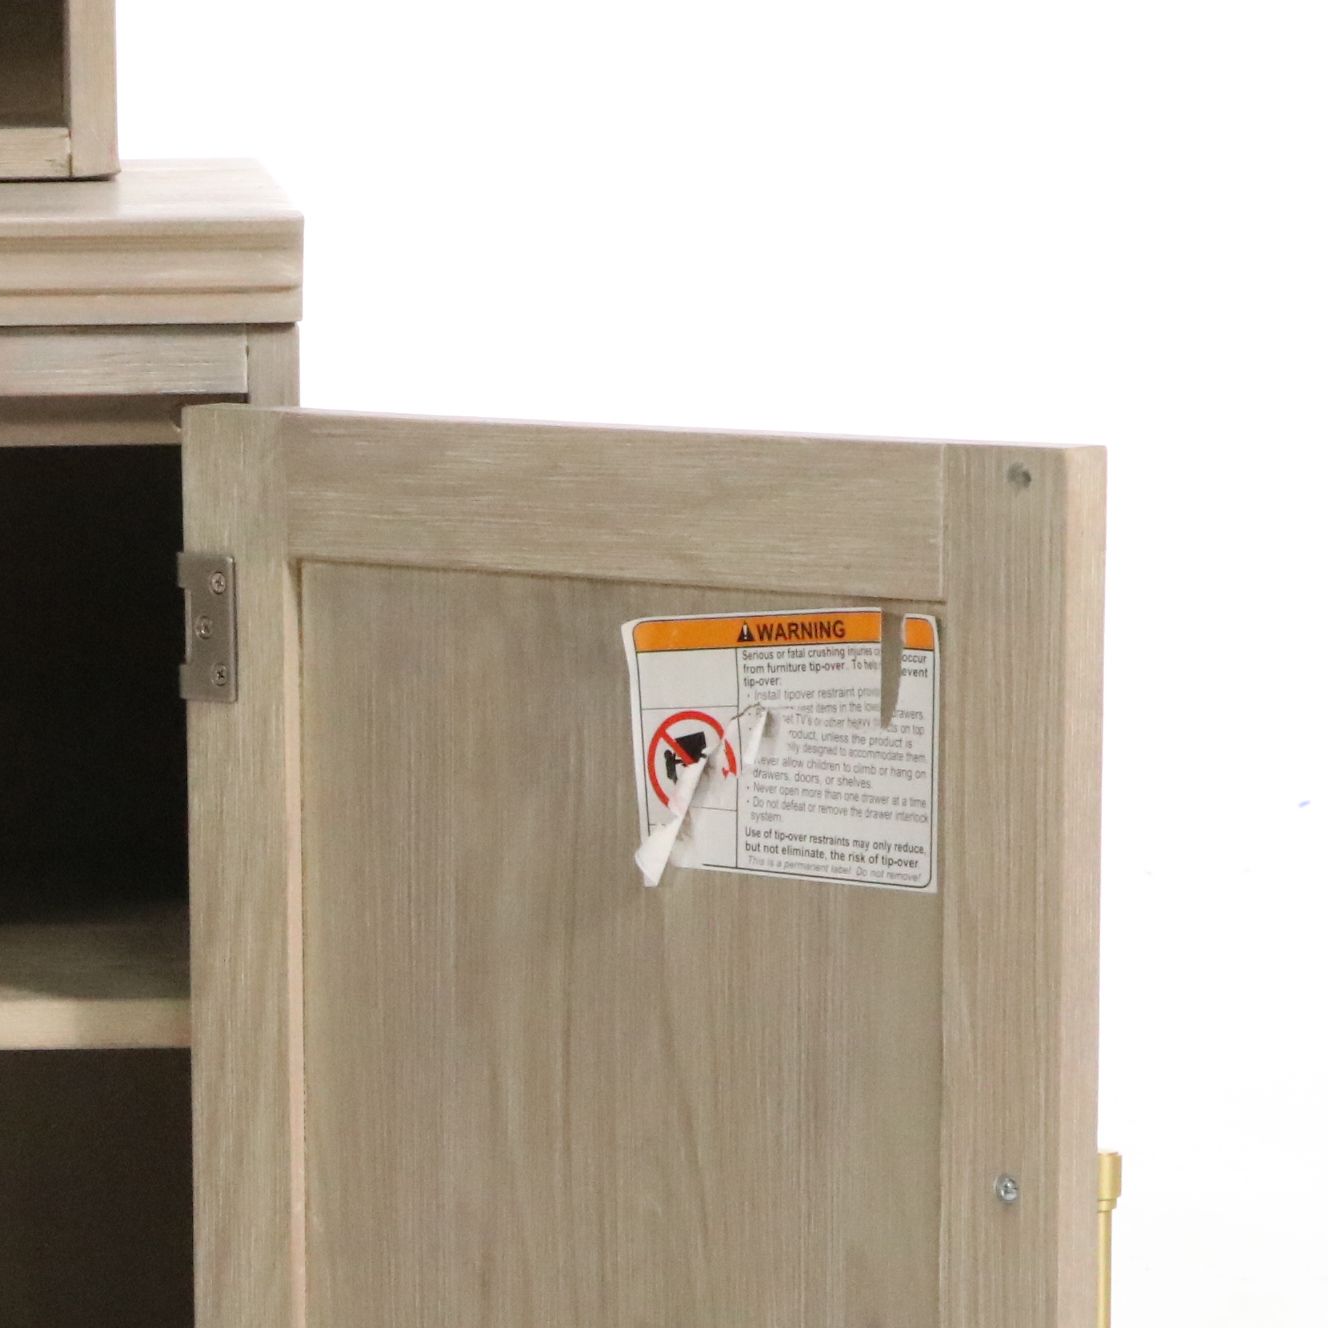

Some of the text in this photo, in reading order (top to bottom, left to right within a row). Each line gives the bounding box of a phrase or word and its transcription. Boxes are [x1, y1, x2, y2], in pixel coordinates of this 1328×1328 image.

[756, 620, 846, 641] WARNING
[742, 650, 774, 660] Serious
[776, 651, 785, 659] or
[787, 648, 806, 658] fatal
[807, 647, 845, 658] crushing
[743, 663, 765, 674] from
[767, 662, 806, 673] furniture
[852, 658, 862, 670] To
[755, 690, 780, 700] Install
[784, 690, 814, 700] tipover
[818, 688, 855, 698] restraint
[849, 703, 862, 712] the
[900, 725, 911, 733] on
[913, 725, 925, 735] top
[821, 732, 849, 743] unless
[852, 734, 866, 745] the
[869, 736, 903, 748] product
[905, 739, 913, 748] is
[848, 748, 904, 761] accommodate
[782, 755, 803, 767] allow
[806, 759, 840, 771] children
[843, 762, 851, 773] to
[853, 763, 877, 775] climb
[879, 767, 888, 776] or
[890, 767, 913, 780] hang
[915, 770, 927, 779] on
[825, 776, 834, 785] or
[753, 781, 777, 794] Never
[779, 785, 799, 799] open
[801, 787, 822, 799] more
[824, 789, 841, 800] than
[844, 792, 859, 801] one
[862, 793, 889, 805] drawer
[892, 796, 900, 805] at
[902, 798, 908, 806] a
[752, 796, 929, 823] Do not defeat or remove the drawer interlock
[745, 826, 927, 855] Use of tip-over restraints may only reduce,
[745, 840, 761, 852] but
[763, 843, 779, 854] not
[781, 845, 827, 860] eliminate,
[830, 850, 845, 861] the
[848, 852, 866, 863] risk
[868, 854, 879, 864] of
[748, 854, 765, 865] This
[767, 858, 775, 867] is
[784, 861, 828, 872] permanent
[856, 866, 868, 877] Do
[870, 869, 884, 879] not
